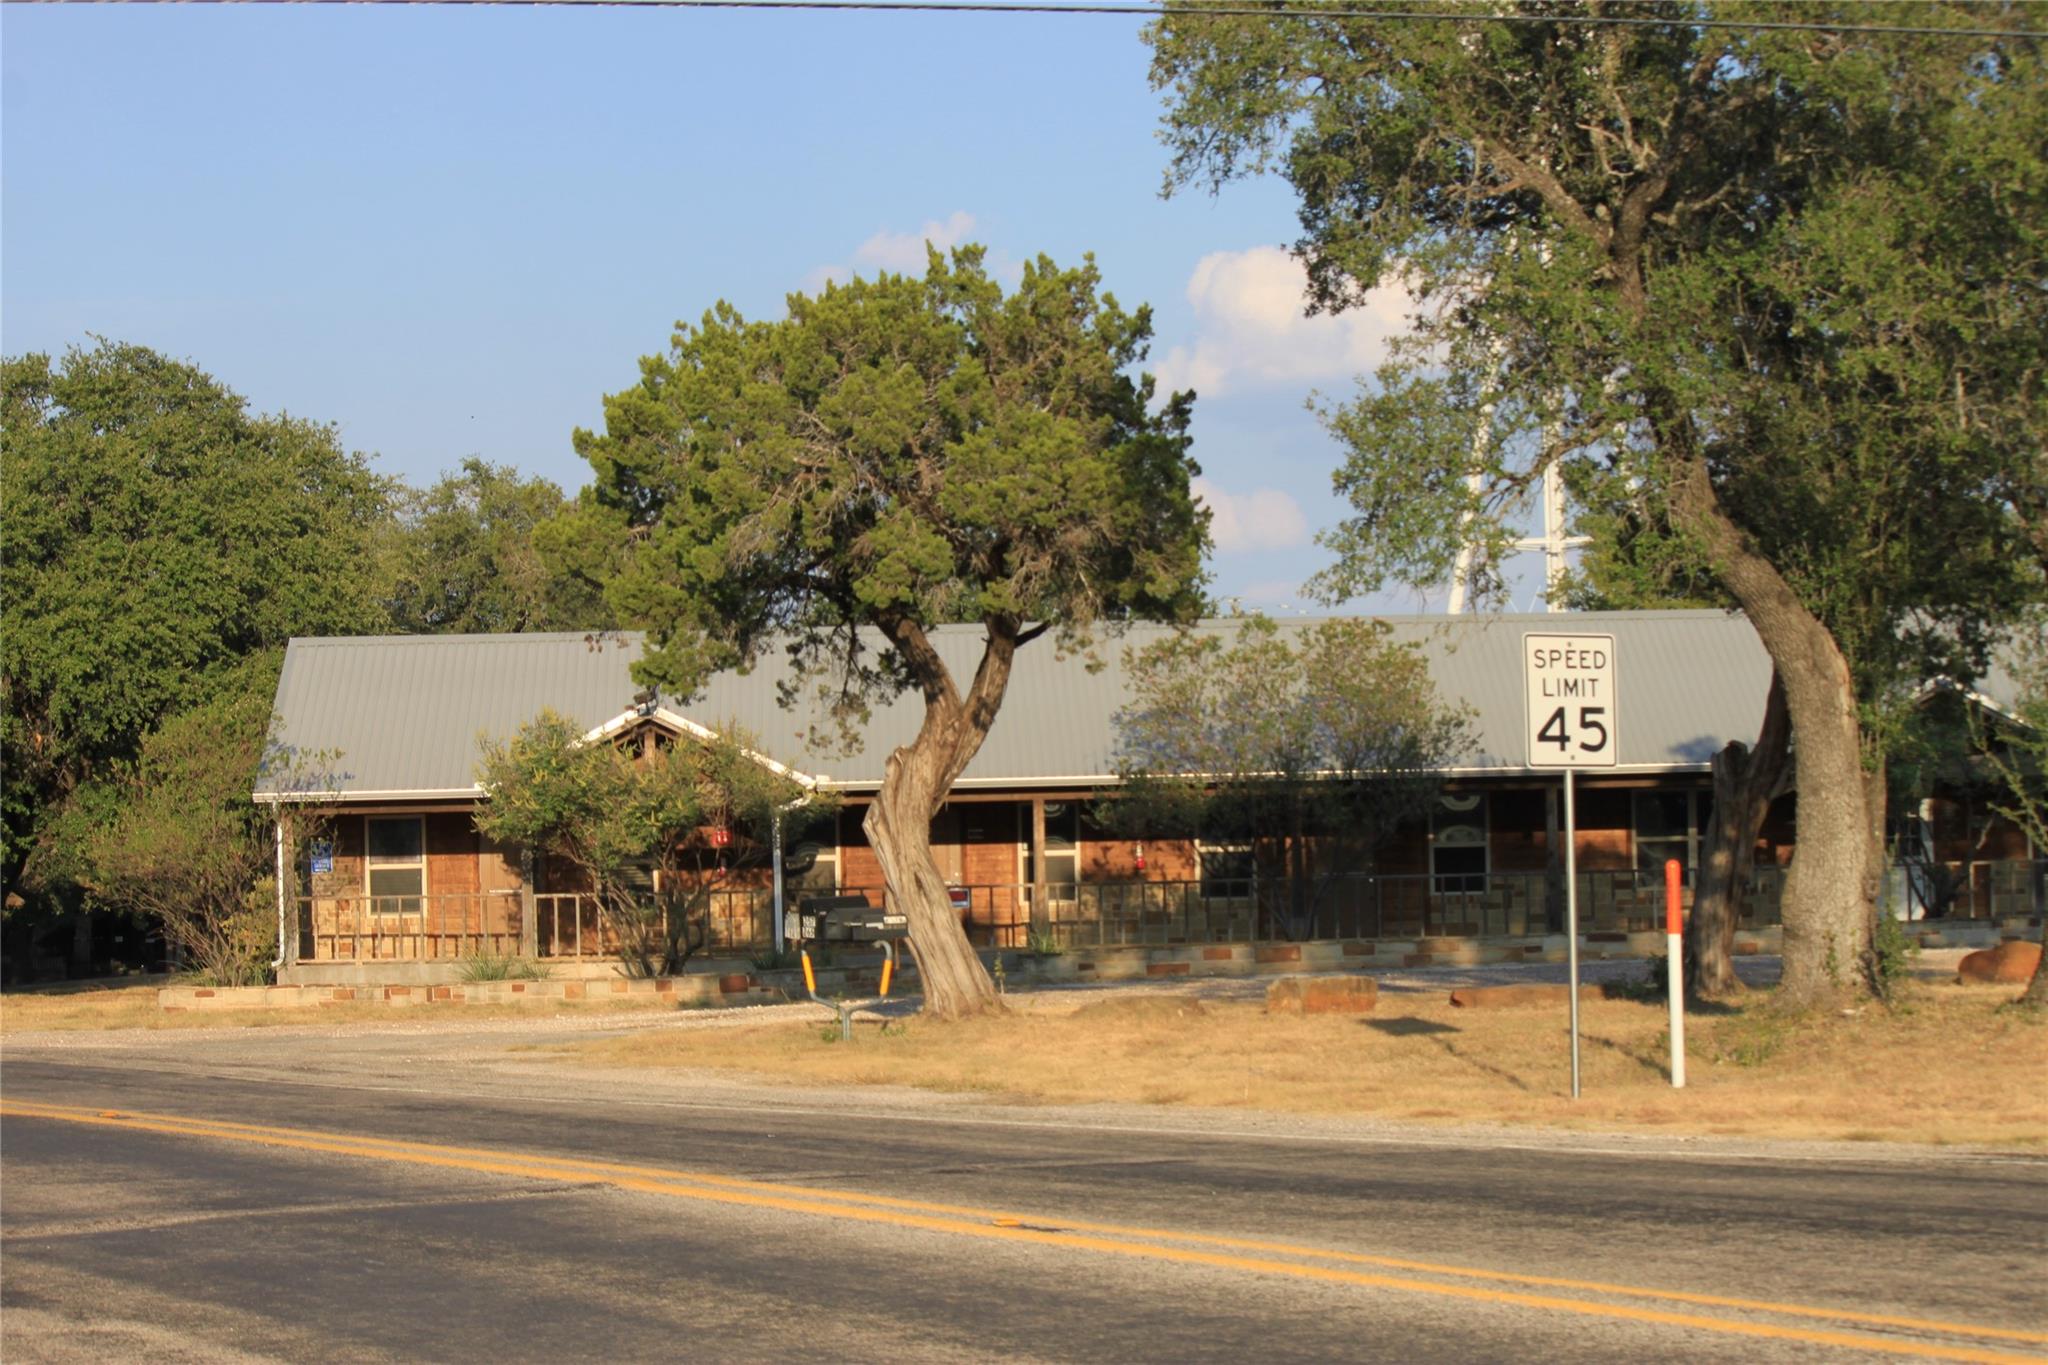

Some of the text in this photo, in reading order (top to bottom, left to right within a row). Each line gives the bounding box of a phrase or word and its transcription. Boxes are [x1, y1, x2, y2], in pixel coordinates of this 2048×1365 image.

[1533, 649, 1606, 669] SPEED
[1542, 678, 1599, 697] LIMIT
[1537, 706, 1607, 752] 45
